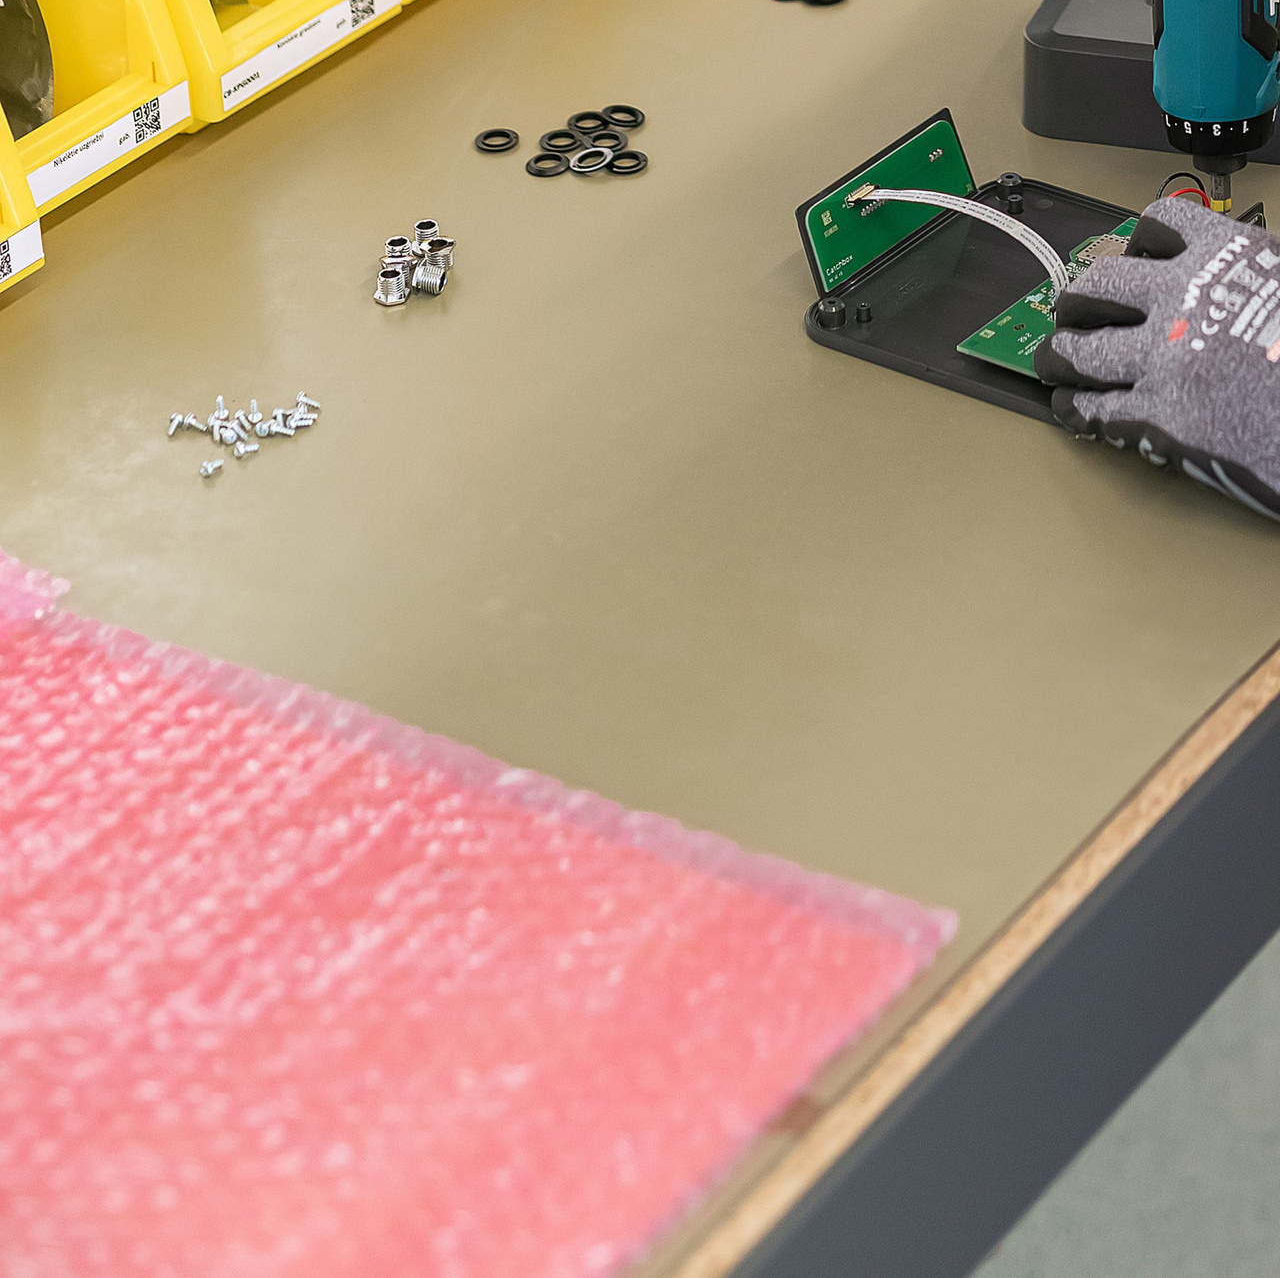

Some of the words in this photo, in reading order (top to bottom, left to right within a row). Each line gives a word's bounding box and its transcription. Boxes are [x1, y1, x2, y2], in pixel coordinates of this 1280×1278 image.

[1183, 121, 1192, 135] 5
[1212, 123, 1221, 136] 3
[826, 254, 853, 277] Catchbox
